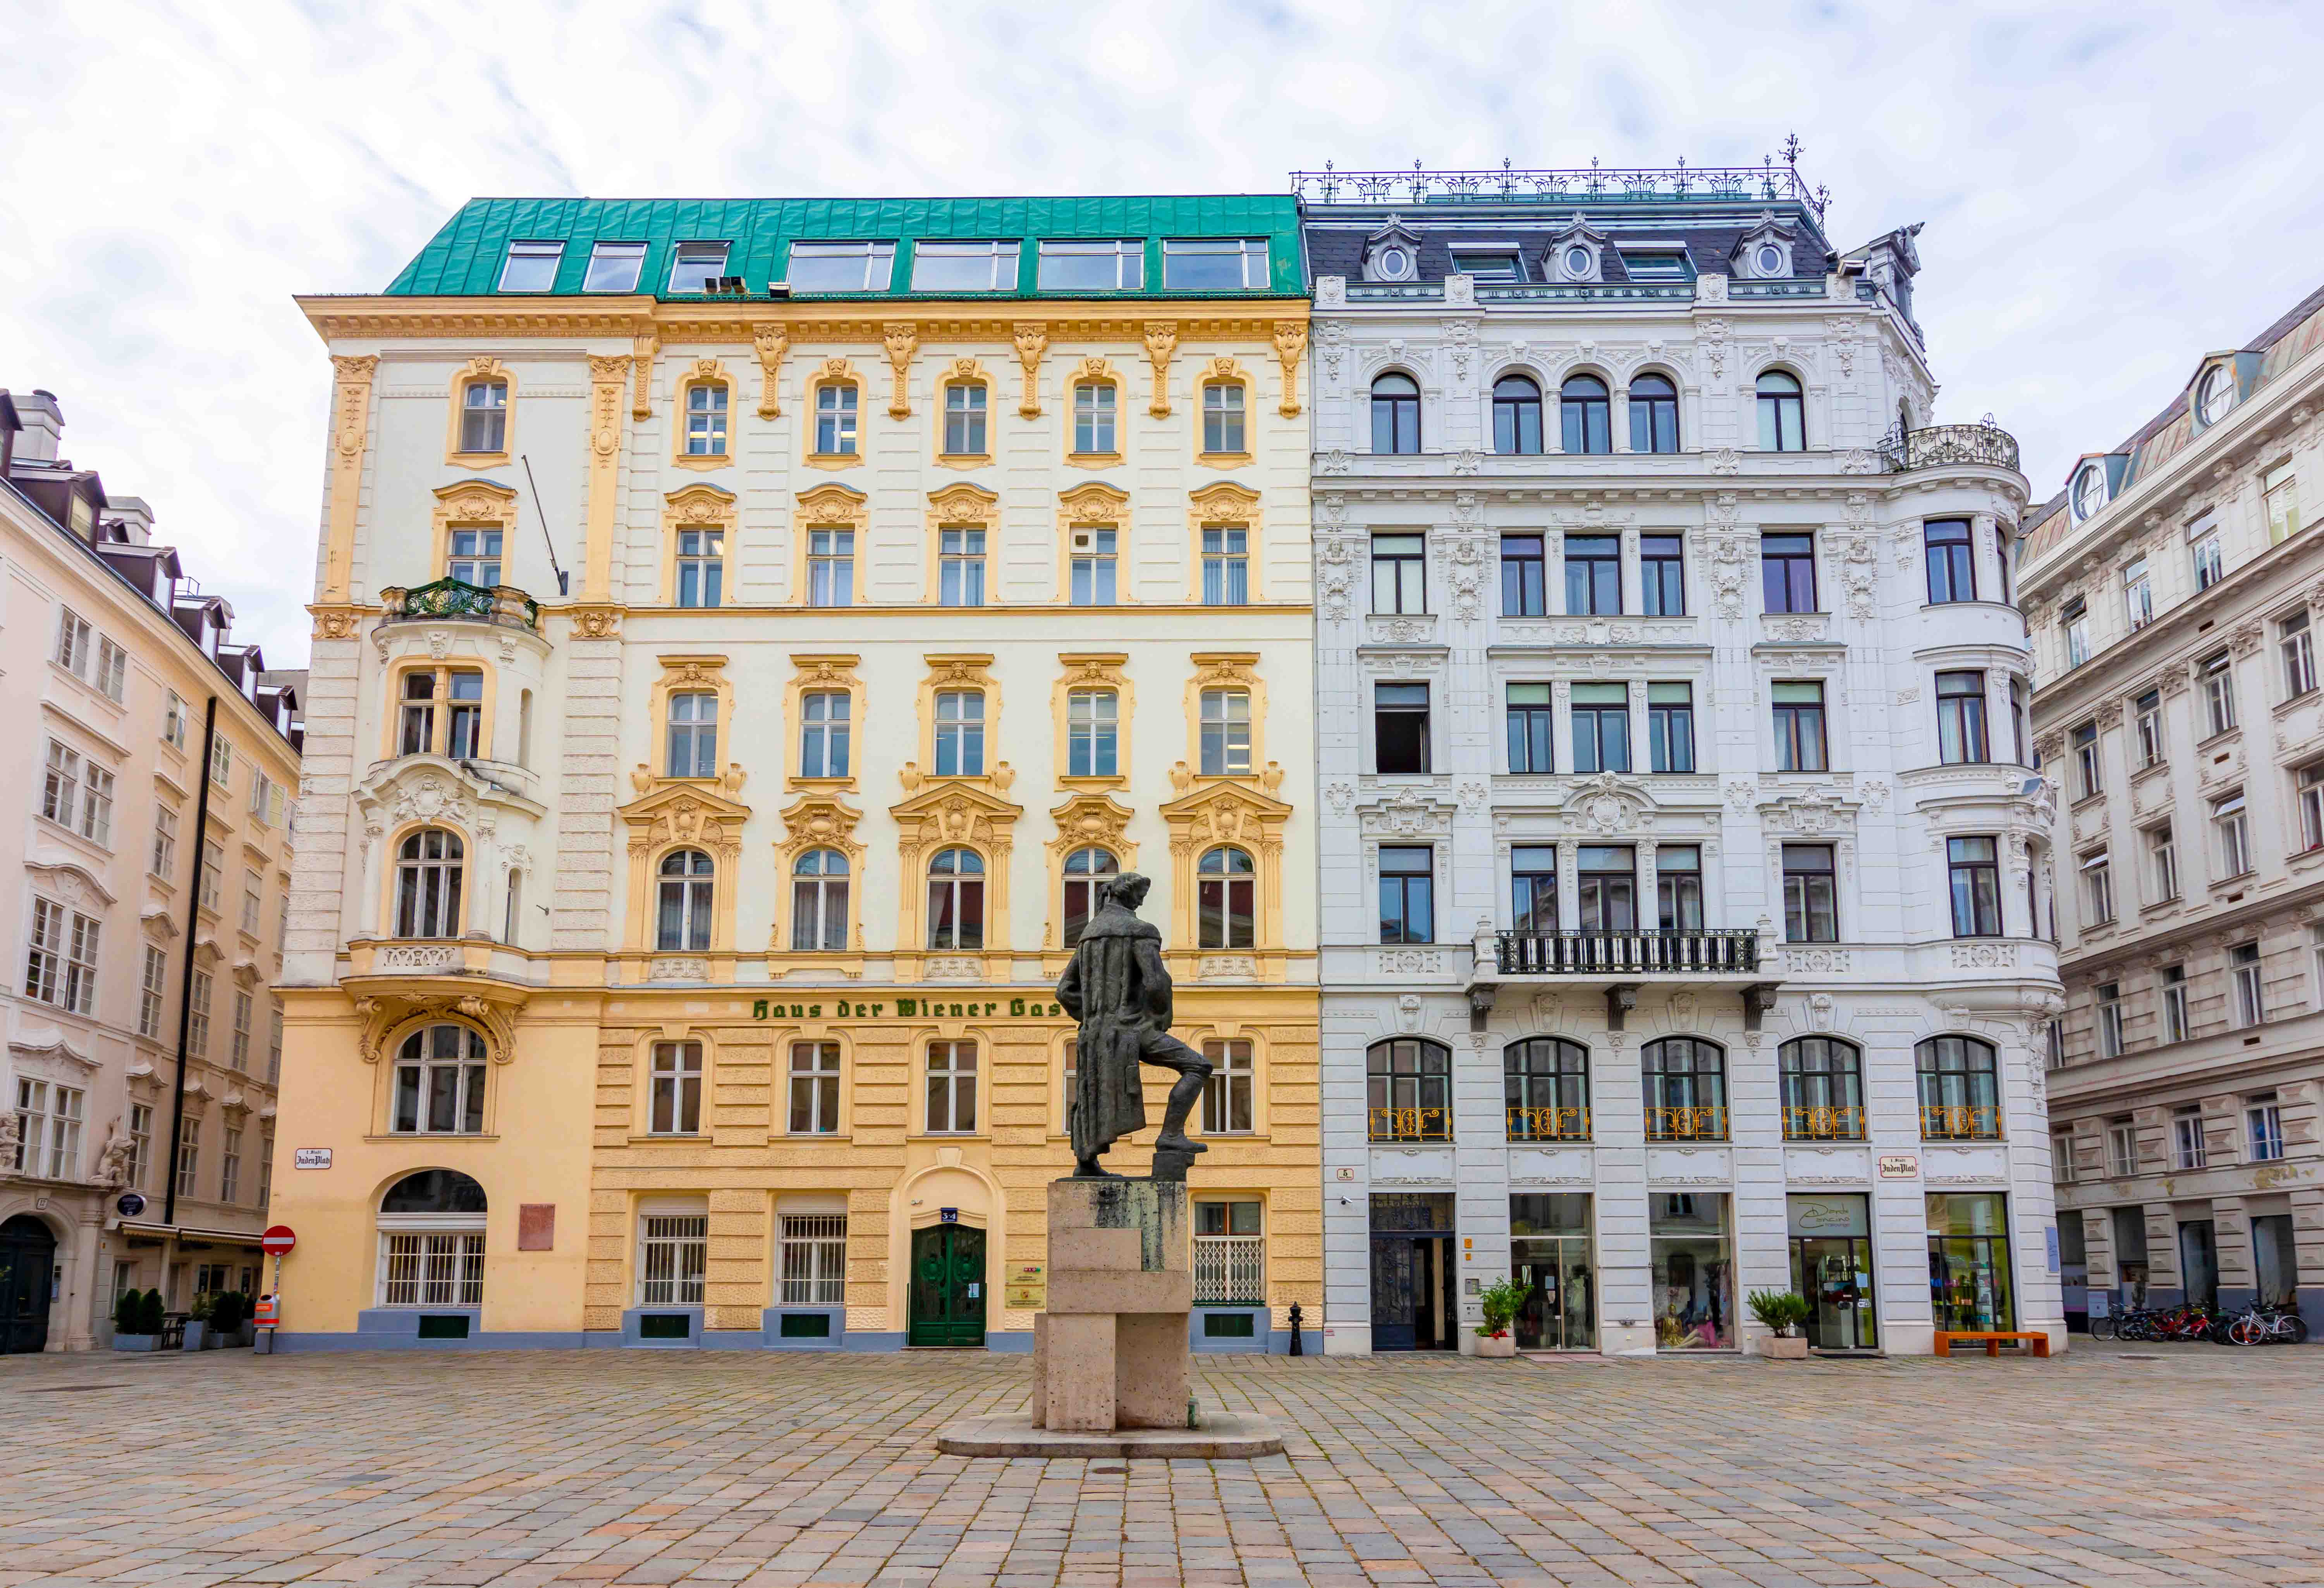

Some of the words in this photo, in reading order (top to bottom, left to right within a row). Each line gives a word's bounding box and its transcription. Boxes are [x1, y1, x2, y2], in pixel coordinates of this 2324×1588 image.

[753, 999, 822, 1020] Haus
[838, 999, 884, 1017] der
[896, 998, 997, 1017] Wiener
